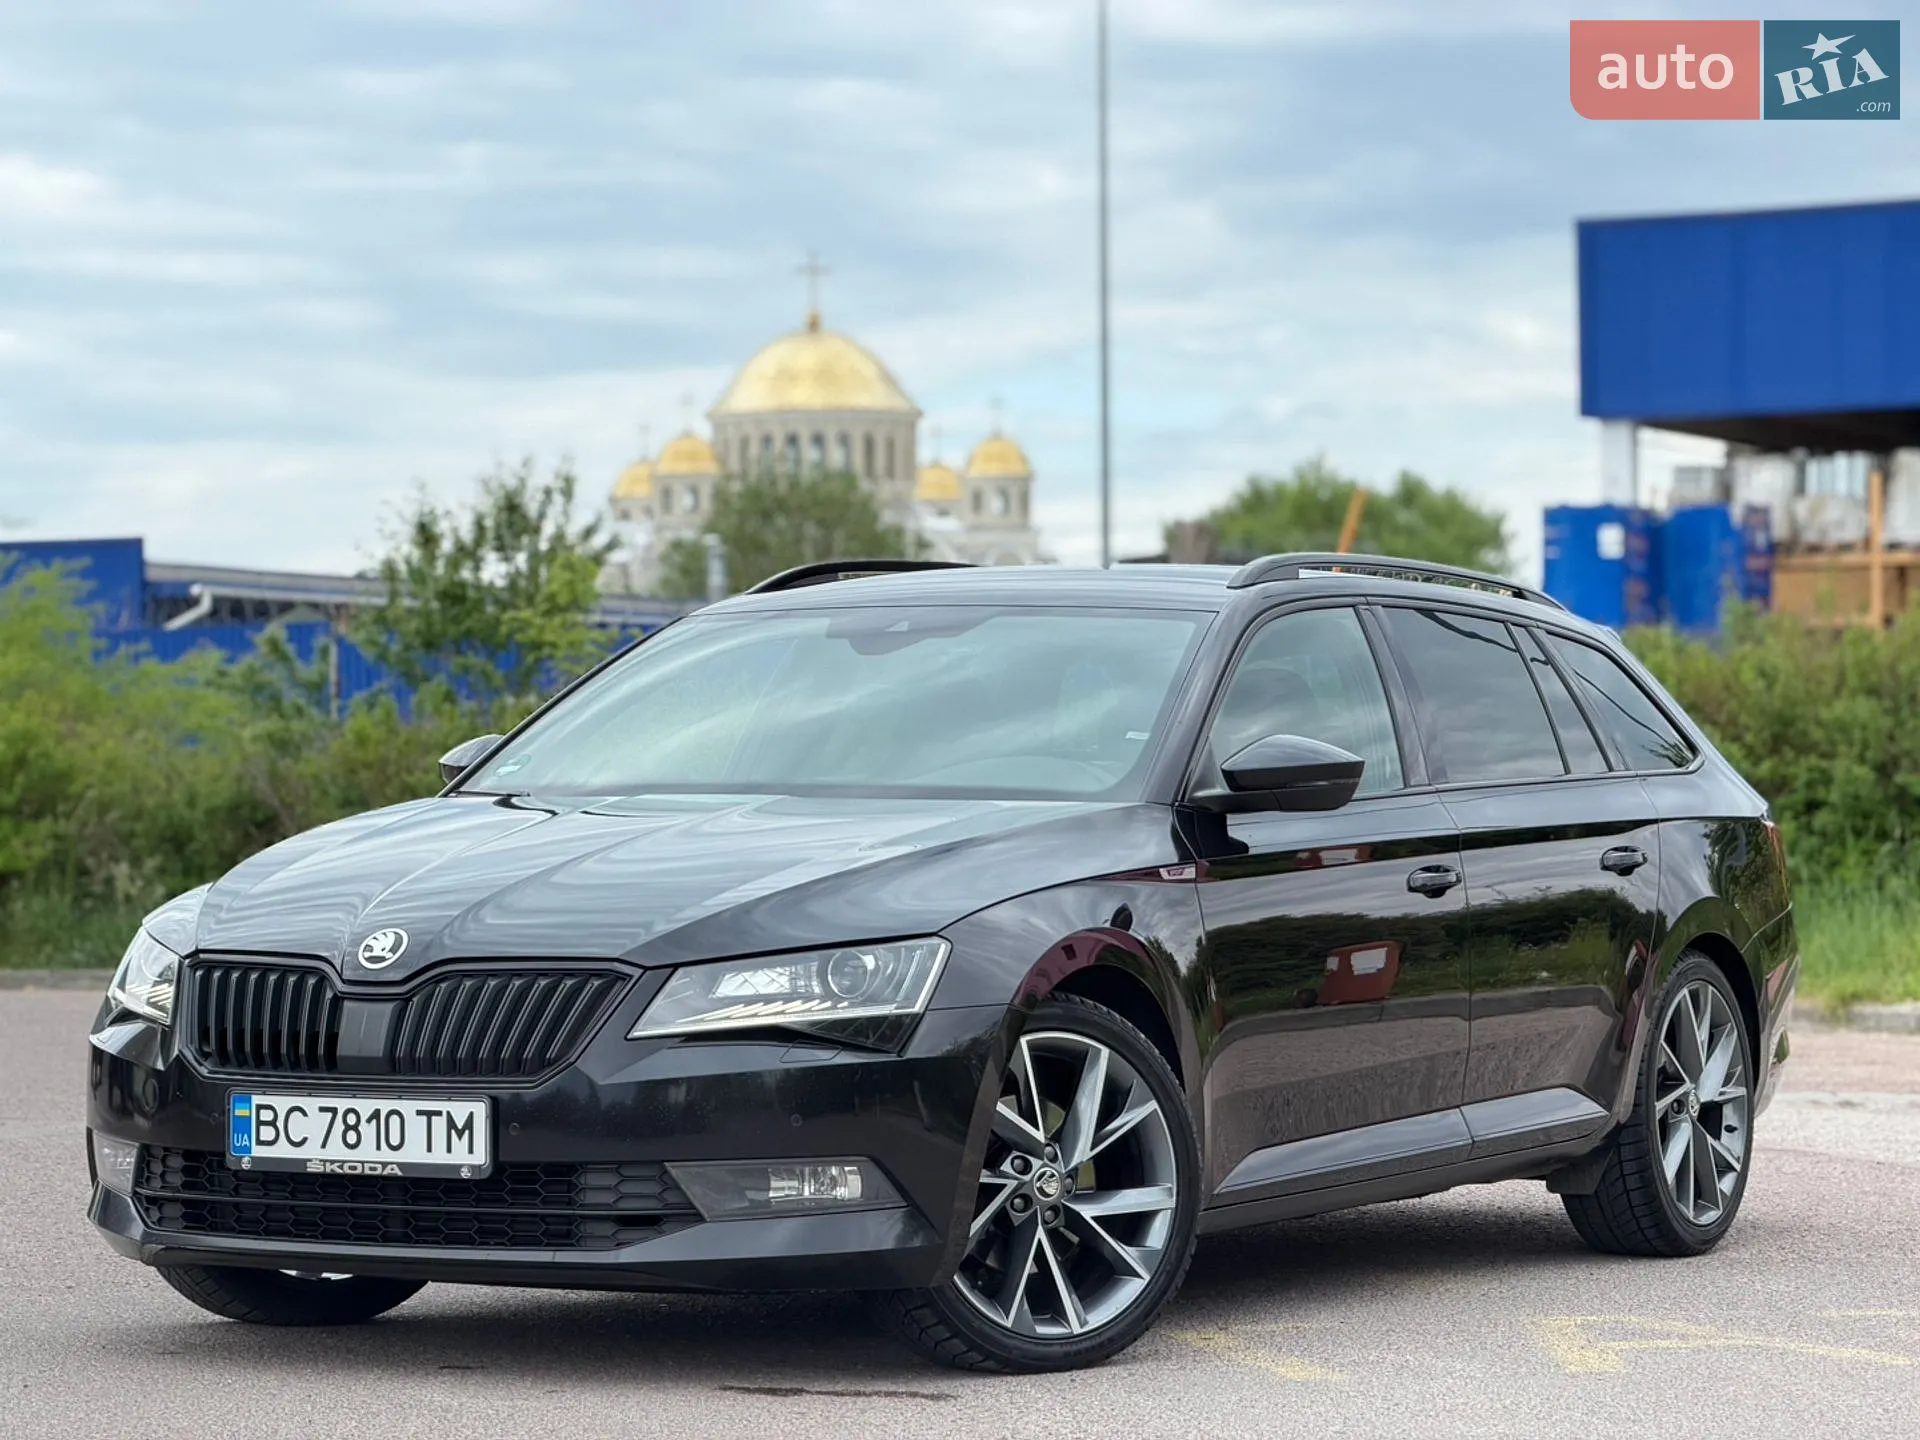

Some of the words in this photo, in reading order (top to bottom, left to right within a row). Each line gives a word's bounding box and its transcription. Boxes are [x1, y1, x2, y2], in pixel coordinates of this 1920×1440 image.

[255, 1103, 309, 1147] BC
[318, 1106, 405, 1151] 7810
[415, 1109, 474, 1154] TM
[234, 1133, 249, 1147] UA
[306, 1158, 403, 1176] ŠKODA
